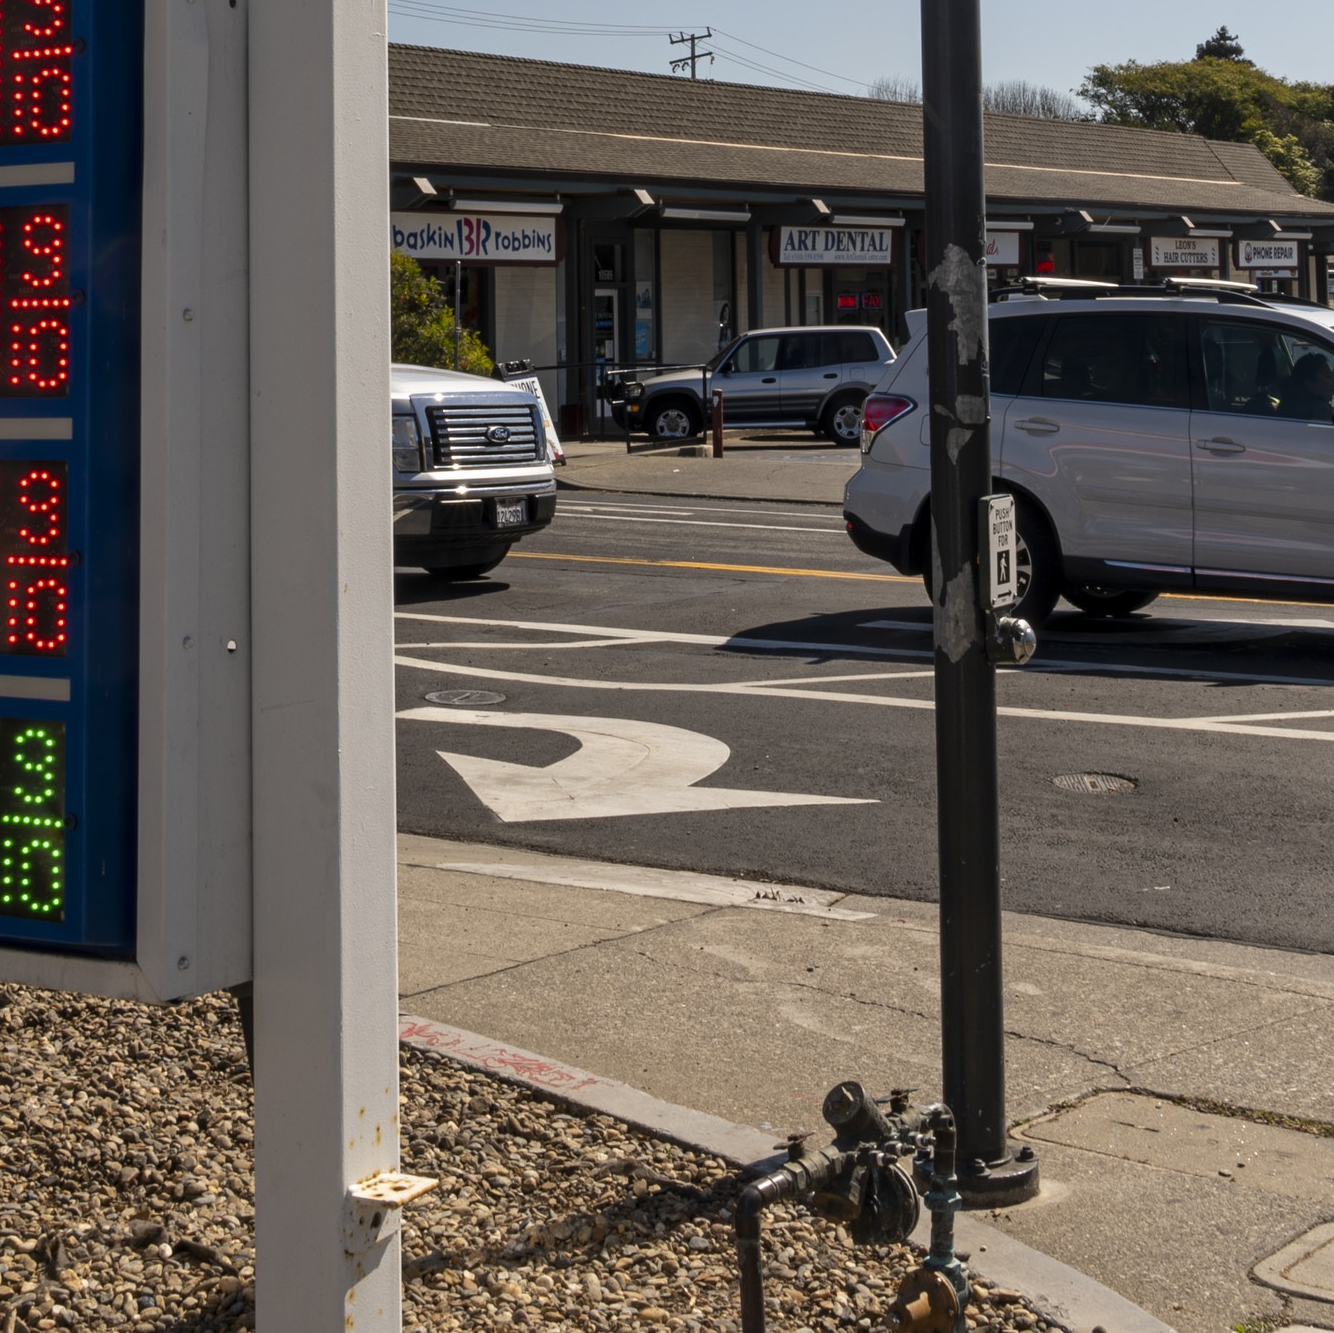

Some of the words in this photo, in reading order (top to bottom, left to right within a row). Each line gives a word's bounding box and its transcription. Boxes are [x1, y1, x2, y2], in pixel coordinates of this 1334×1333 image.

[392, 223, 455, 251] baskin
[495, 229, 552, 254] robbins
[783, 229, 820, 251] ART
[823, 230, 889, 252] DENTAL
[1175, 240, 1196, 250] LEON'S
[1163, 252, 1180, 263] HAIR
[1180, 253, 1209, 264] CUTTERS
[1252, 246, 1272, 259] PHONE
[1273, 247, 1294, 260] REPAIR
[995, 507, 1010, 521] PUSH
[992, 520, 1013, 535] BUTTON
[998, 534, 1009, 548] FOR
